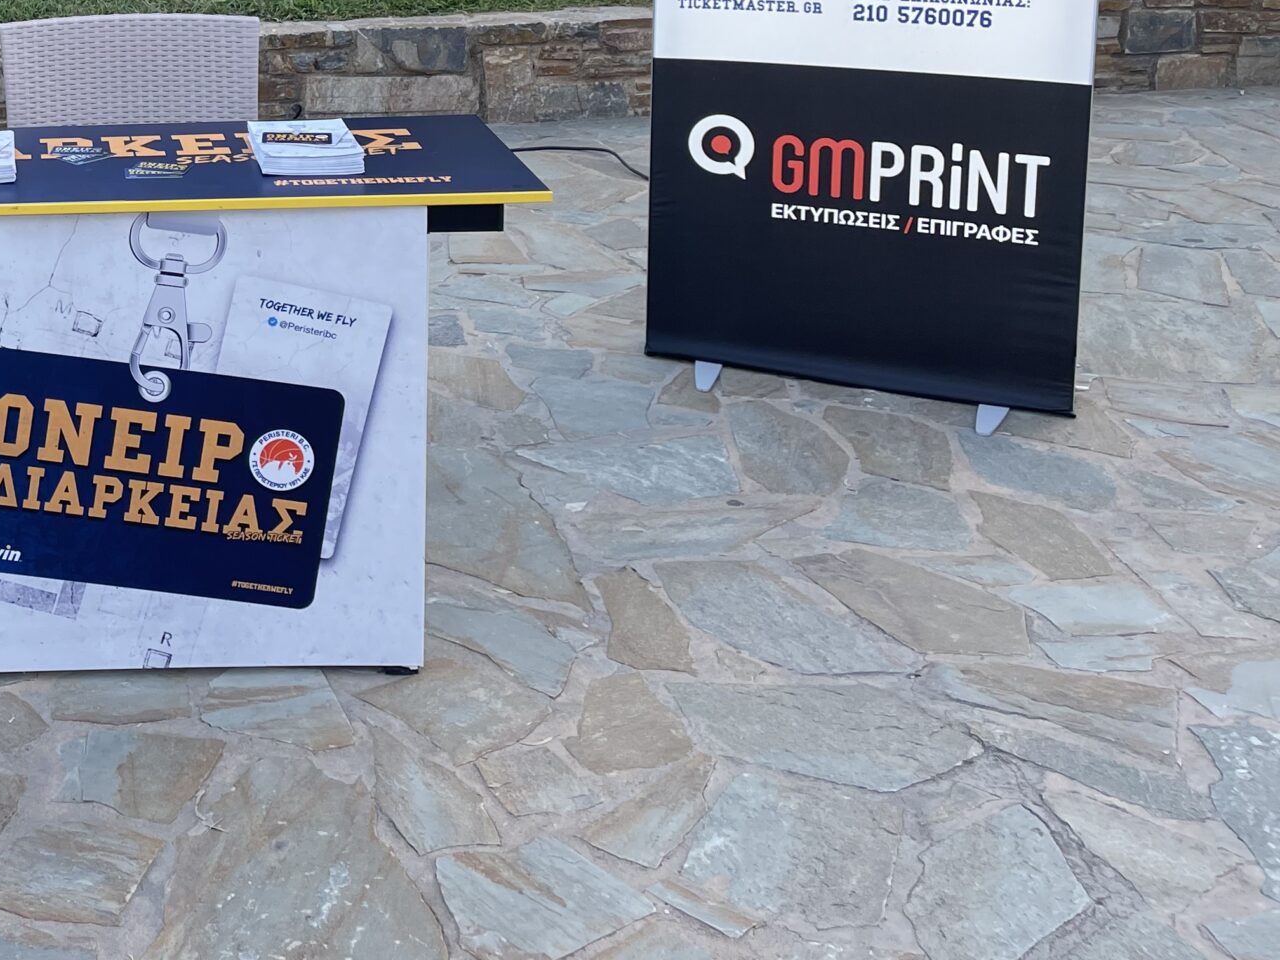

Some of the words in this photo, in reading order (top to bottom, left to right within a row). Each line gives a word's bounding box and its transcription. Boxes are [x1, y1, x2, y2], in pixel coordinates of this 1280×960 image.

[852, 4, 889, 23] 210
[896, 6, 993, 29] 5760076
[272, 174, 452, 188] #TOGETHERWEFLY
[770, 204, 901, 231] ΕΚΤΥΠΩΣΕΙΣ
[916, 218, 1040, 246] ΕΠΙΓΡΑΦΕΣ
[259, 298, 315, 319] TOGETHER
[317, 311, 334, 322] WE
[335, 314, 358, 327] FLY
[279, 320, 338, 340] @Peristeribc
[258, 430, 299, 445] PERISTERI
[226, 531, 267, 542] SEASON
[267, 532, 301, 543] TICKET
[231, 580, 294, 595] #TOGETHERWEFLY
